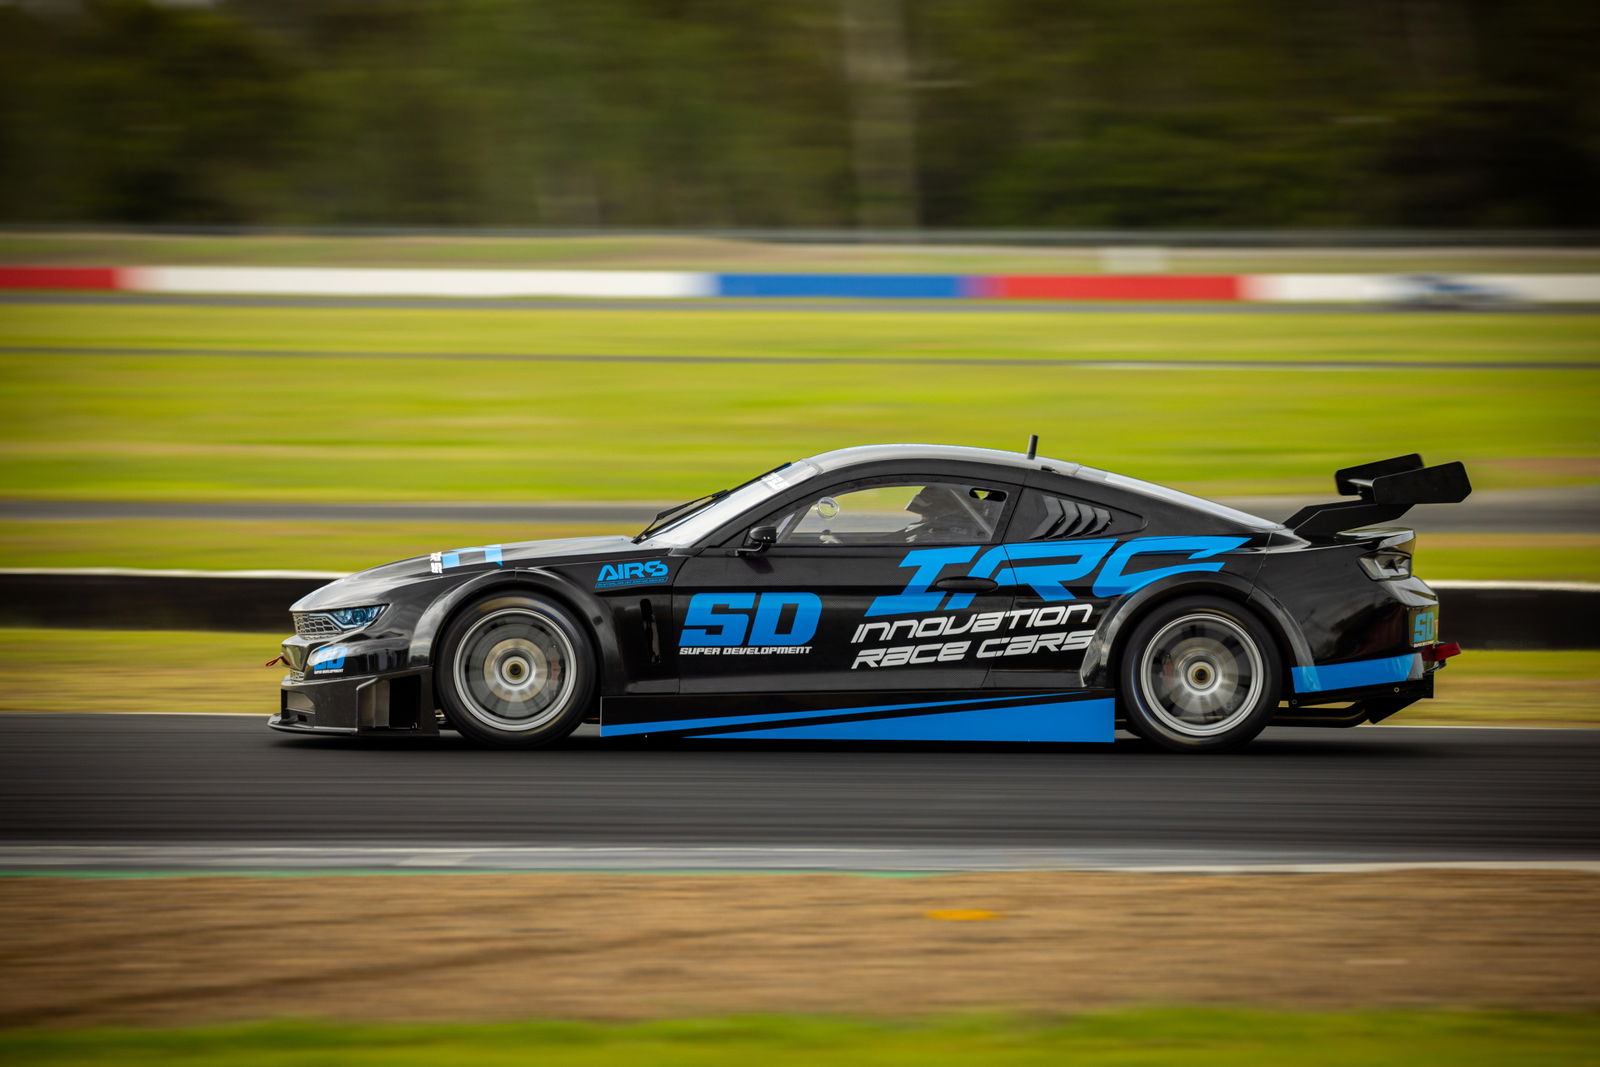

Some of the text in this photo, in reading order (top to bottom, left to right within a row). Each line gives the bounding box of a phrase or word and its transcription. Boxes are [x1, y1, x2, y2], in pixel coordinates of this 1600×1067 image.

[597, 560, 669, 582] AIRS
[864, 535, 1252, 617] IRC
[678, 592, 823, 647] SD
[679, 646, 813, 656] SUPER DEVELOPMENT
[850, 629, 1098, 670] RACE CARS
